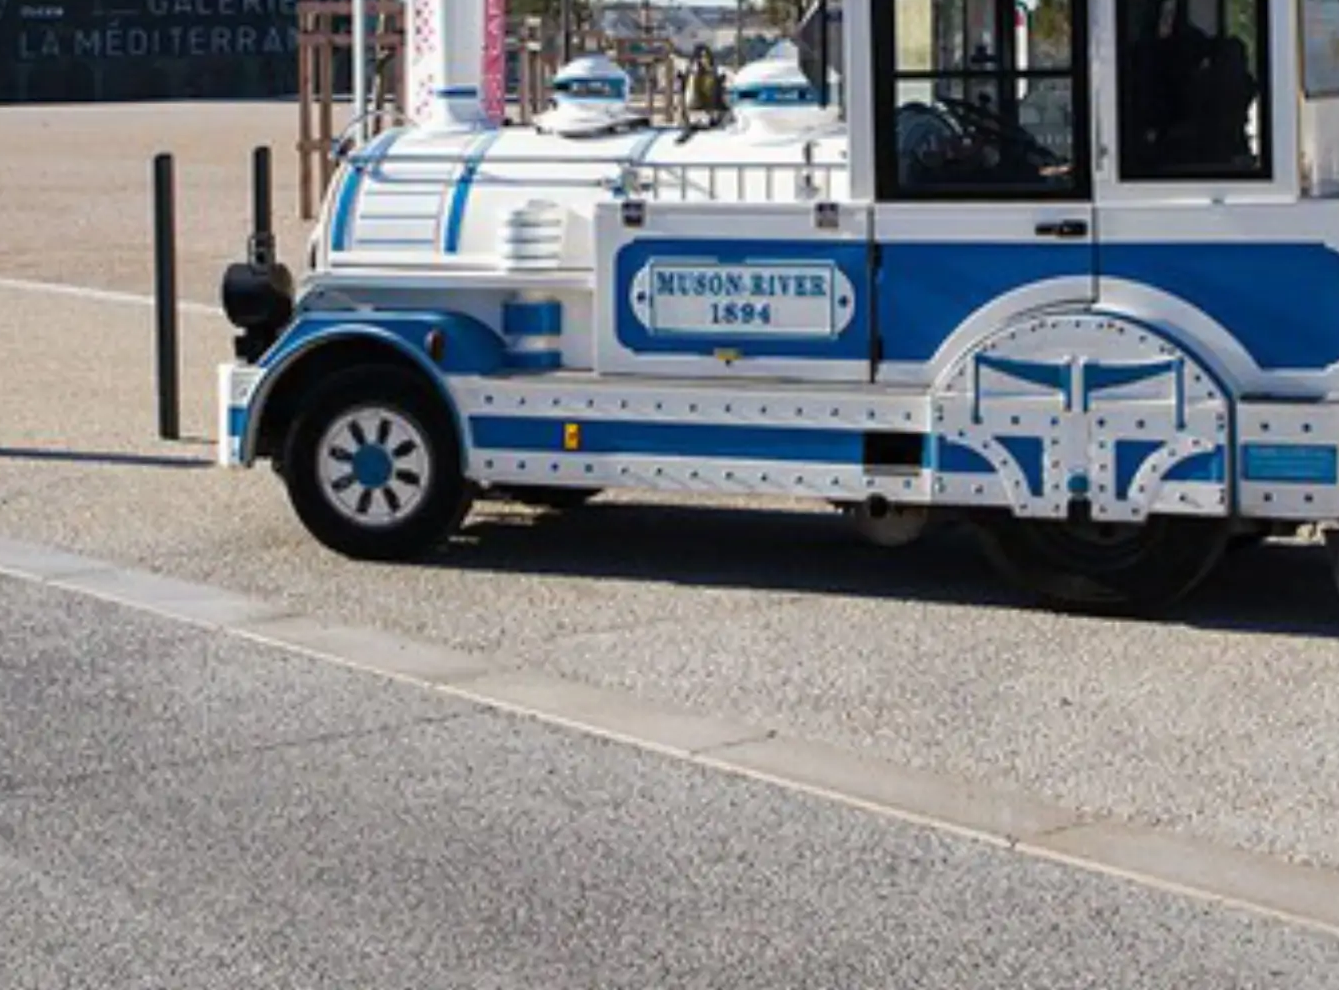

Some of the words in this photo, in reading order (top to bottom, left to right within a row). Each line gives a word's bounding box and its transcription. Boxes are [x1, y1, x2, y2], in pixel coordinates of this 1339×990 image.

[17, 29, 61, 58] LA
[73, 19, 303, 57] MÉDITERRAN
[710, 302, 772, 325] 1894
